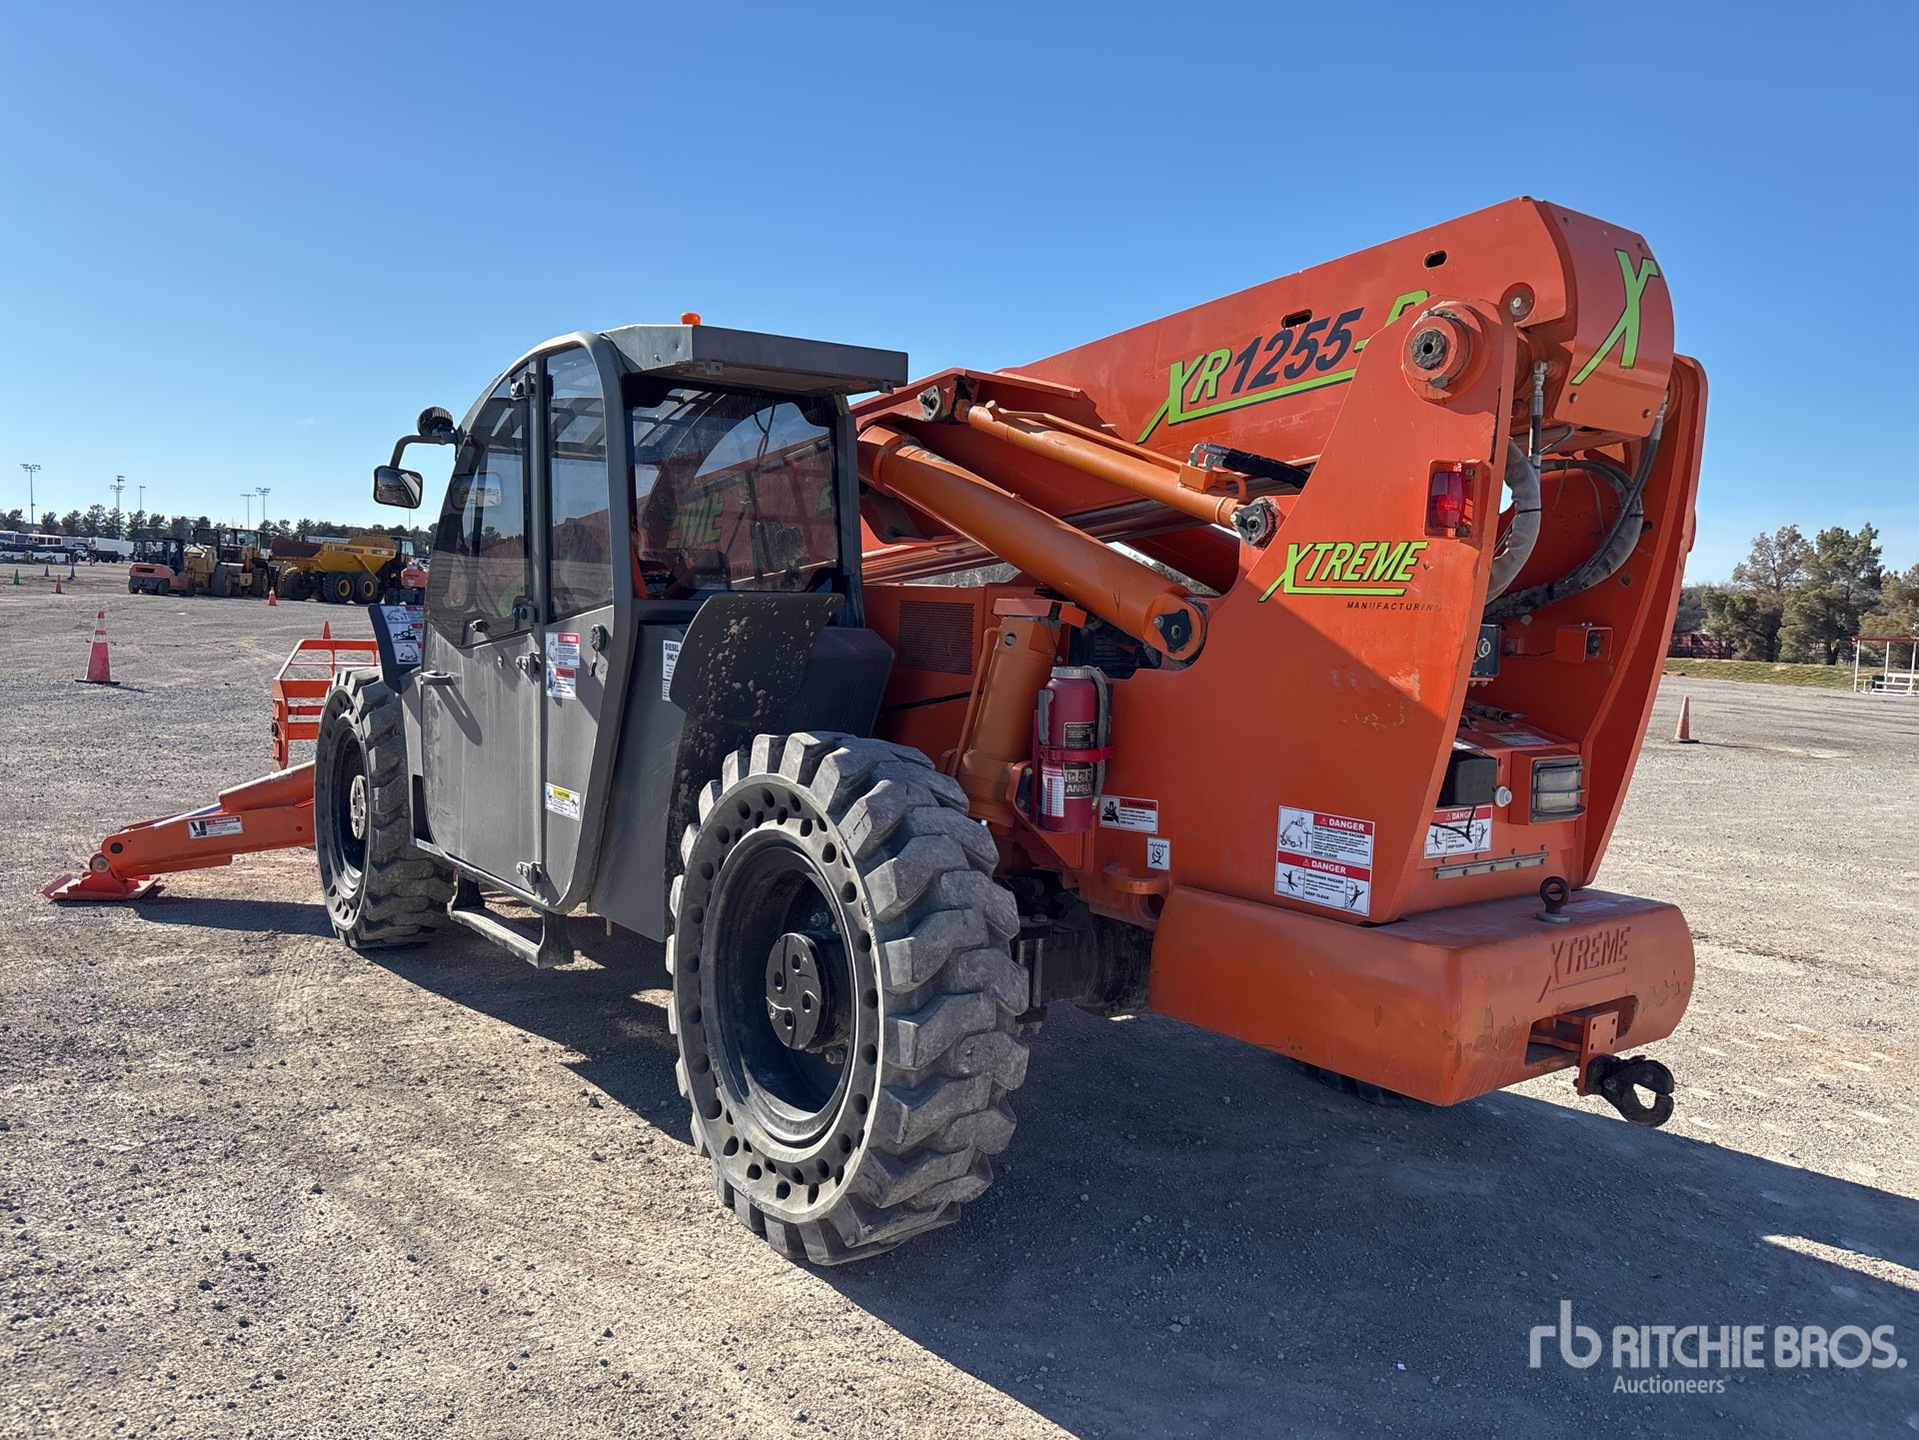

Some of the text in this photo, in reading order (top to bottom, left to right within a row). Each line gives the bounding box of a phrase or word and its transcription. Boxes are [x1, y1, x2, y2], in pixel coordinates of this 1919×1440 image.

[1257, 541, 1430, 603] XTREME
[1346, 601, 1442, 612] MANUFACTURING
[1328, 818, 1365, 831] DANGER
[1311, 860, 1346, 874] DANGER
[1537, 926, 1631, 1003] XTREME
